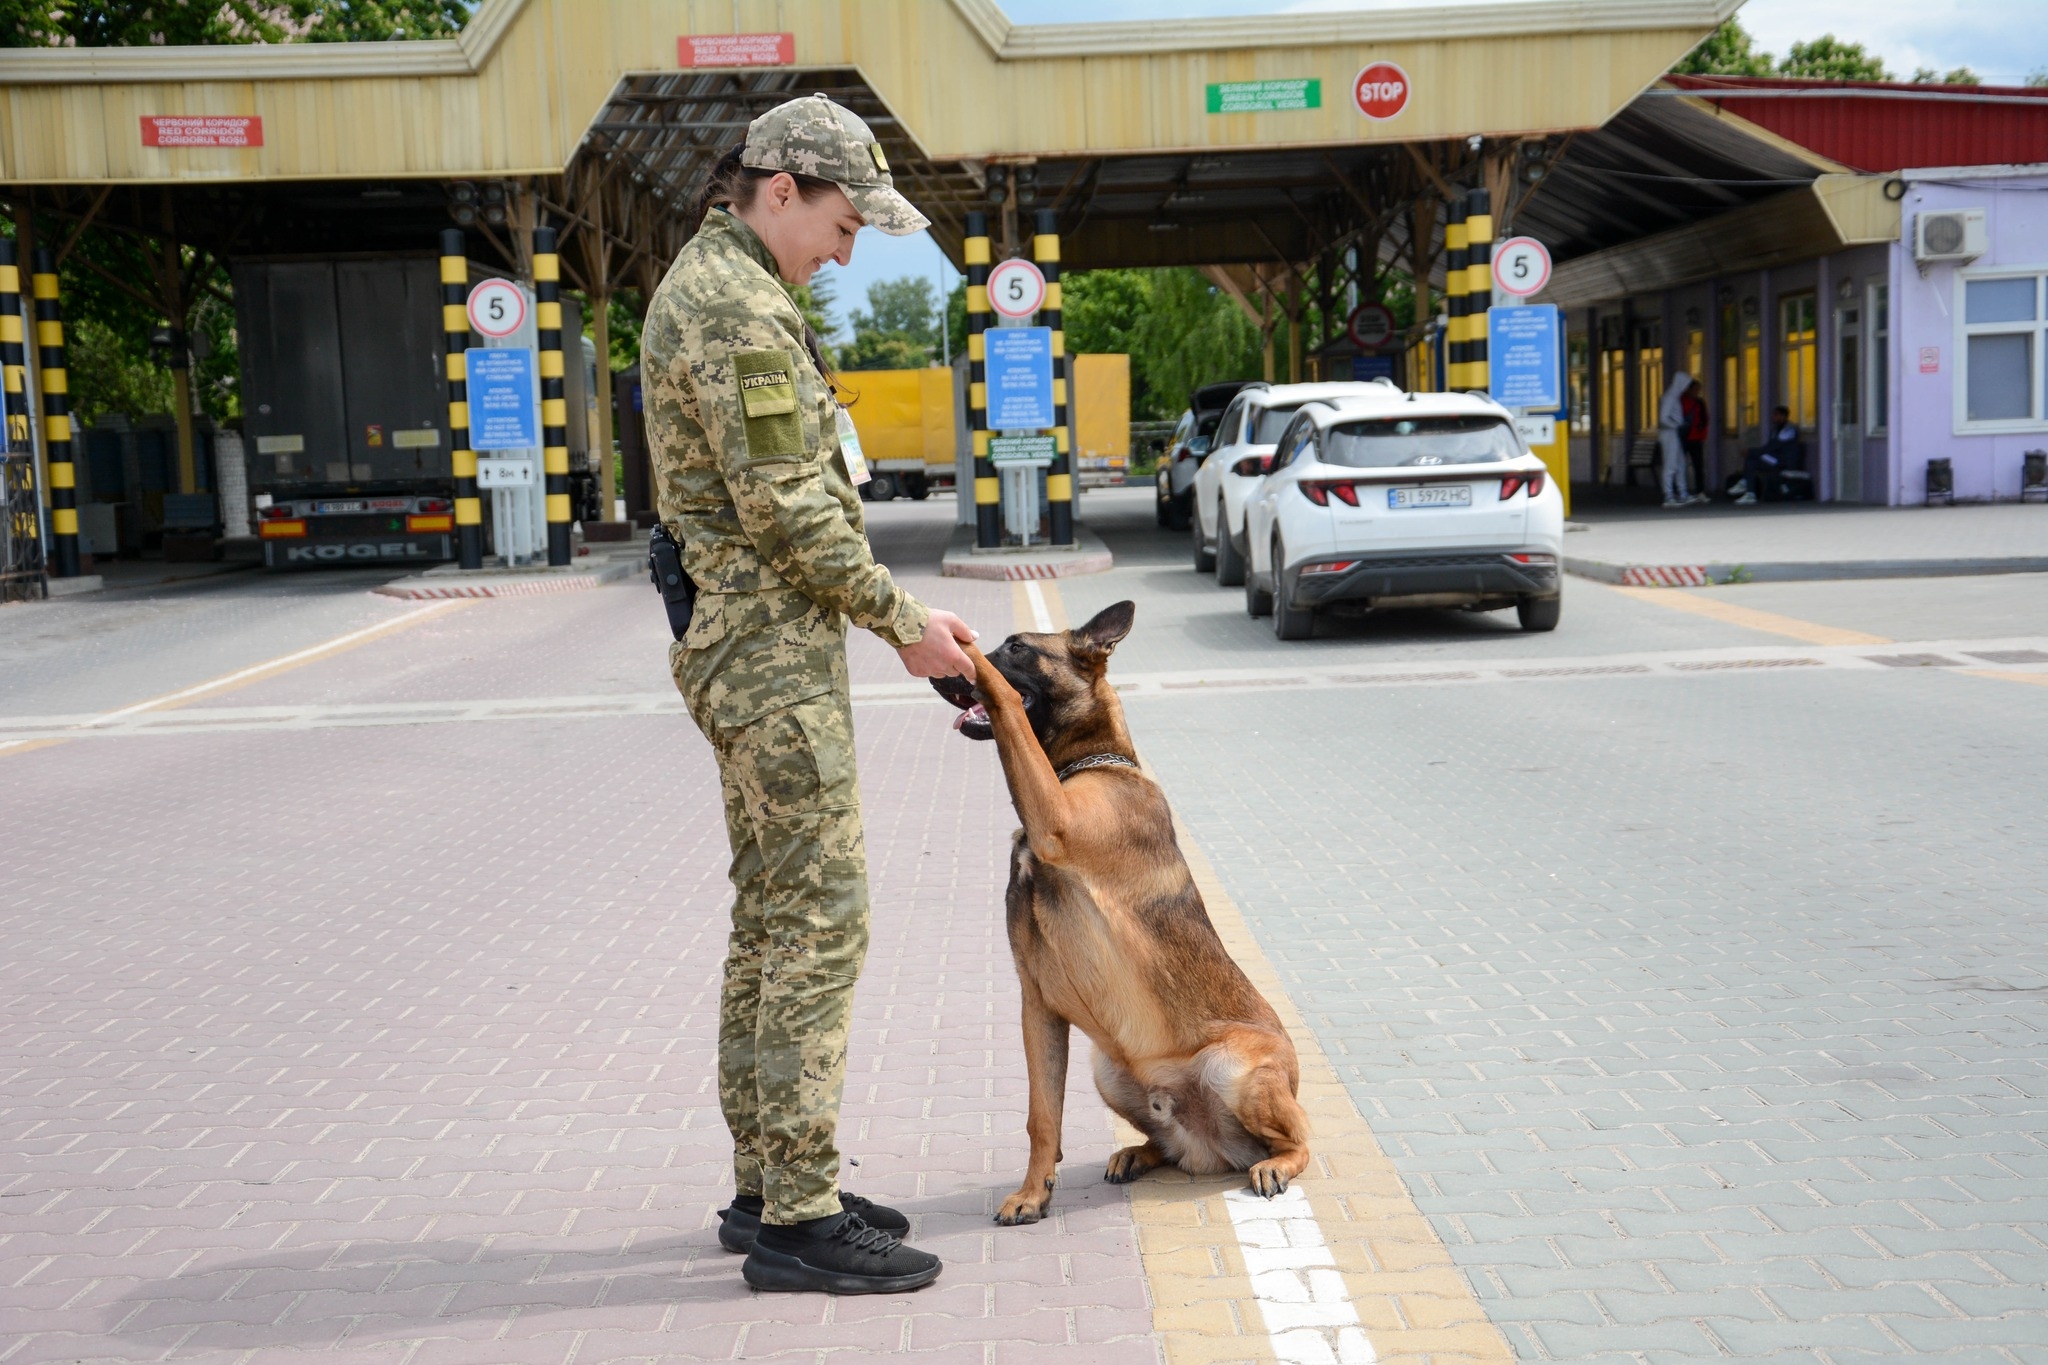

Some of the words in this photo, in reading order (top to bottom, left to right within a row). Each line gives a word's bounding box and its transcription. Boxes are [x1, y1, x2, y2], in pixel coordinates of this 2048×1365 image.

[694, 46, 717, 54] RED
[719, 44, 777, 53] CORRIDOR
[1361, 82, 1404, 102] STOP
[153, 117, 204, 127] ЧЕРВОНИЙ
[205, 118, 251, 127] КОРИДОР
[158, 127, 182, 135] RED
[184, 127, 245, 135] CORRIDOR
[158, 136, 217, 144] CORIDORUL
[1514, 256, 1528, 278] 5
[1009, 278, 1023, 300] 5
[489, 297, 504, 320] 5
[743, 373, 788, 388] УКРАЇНА
[1418, 489, 1447, 502] 5972
